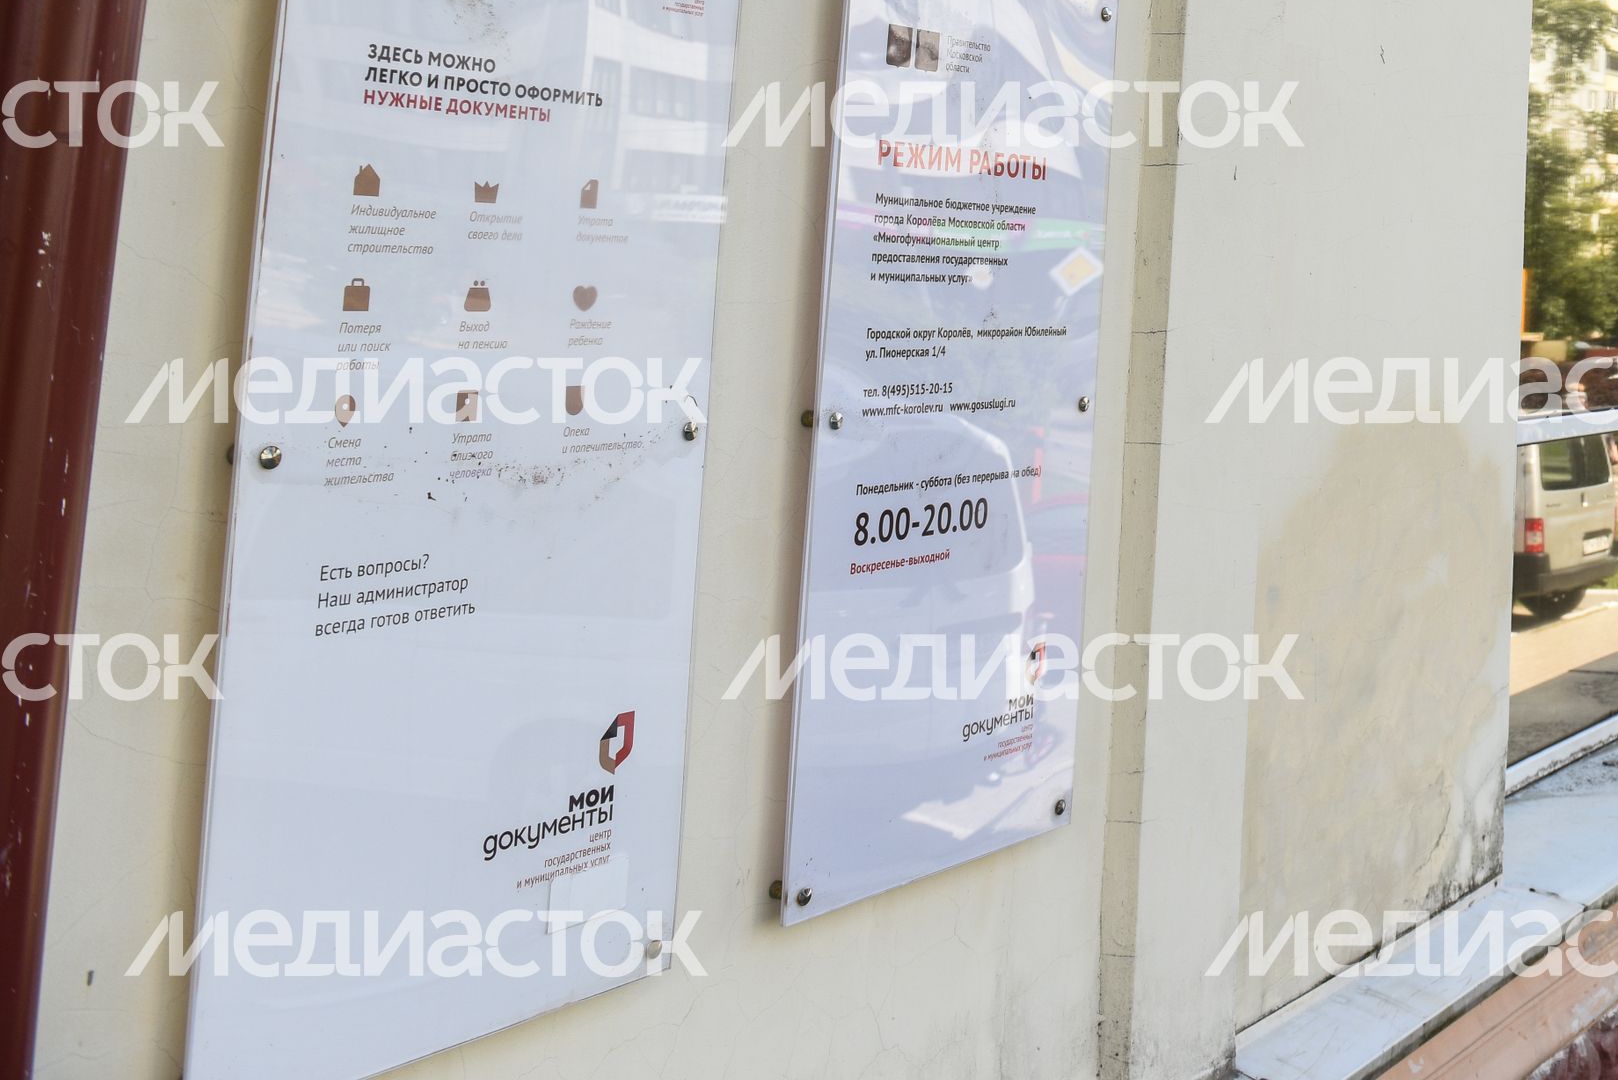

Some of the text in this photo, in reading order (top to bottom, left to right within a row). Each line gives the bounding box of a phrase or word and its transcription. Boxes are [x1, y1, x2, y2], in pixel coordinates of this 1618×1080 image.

[368, 43, 496, 73] ЗДЕСЬ МОЖНО
[365, 66, 603, 107] ЛЕГКО И ПРОСТО ОФОРМИТЬ
[363, 89, 550, 122] НУЖНЫЕ ДОКУМЕНТЫ
[878, 139, 1047, 181] РЕЖИМ РАБОТЫ
[351, 204, 437, 220] Индивидуальное
[875, 193, 1036, 216] Муниципальное бюджетное учреждение
[469, 211, 523, 225] Открытие
[874, 213, 1026, 232] города Королёва Московской области
[349, 224, 405, 237] жилищное
[468, 230, 499, 241] своего
[873, 232, 999, 249] «Многофункциональный центр
[347, 243, 434, 256] строительство
[872, 253, 1008, 267] предоставления государственных
[870, 273, 876, 281] и
[878, 271, 946, 284] муниципальных
[339, 322, 382, 335] Потеря
[459, 321, 490, 333] Выход
[866, 327, 911, 341] Городской
[913, 328, 936, 341] округ
[976, 327, 1023, 339] микрорайон
[1024, 325, 1067, 338] Юбилейный
[337, 342, 391, 352] или поиск
[458, 340, 508, 350] на пенсию
[865, 345, 946, 362] ул. Пионерская 1/4
[863, 382, 953, 399] тел. 8(495)515-20-15
[862, 397, 1016, 418] www.mfc-korolev.ru www.gosuslugi.ru
[451, 431, 492, 444] Утрата
[563, 427, 590, 438] Опека
[328, 437, 361, 448] Смена
[326, 456, 361, 467] места
[450, 450, 493, 462] близкого
[324, 471, 394, 486] жительства
[450, 467, 492, 479] человека
[856, 479, 914, 496] Понедельник
[920, 475, 952, 491] суббота
[954, 474, 970, 488] (без
[972, 468, 1009, 484] перерыва
[1010, 468, 1020, 479] на
[1021, 465, 1042, 480] обед)
[853, 496, 989, 547] 8.00-20.00
[320, 553, 430, 581] Есть вопросы?
[850, 550, 951, 575] Воскресенье-выходной
[317, 578, 469, 609] Наш администратор
[315, 603, 475, 637] всегда готов ответить
[962, 707, 1034, 742] документы
[483, 804, 613, 861] документы
[589, 828, 612, 843] центр
[544, 842, 611, 868] государственных
[524, 861, 588, 888] муниципальных
[590, 854, 610, 868] услуг
